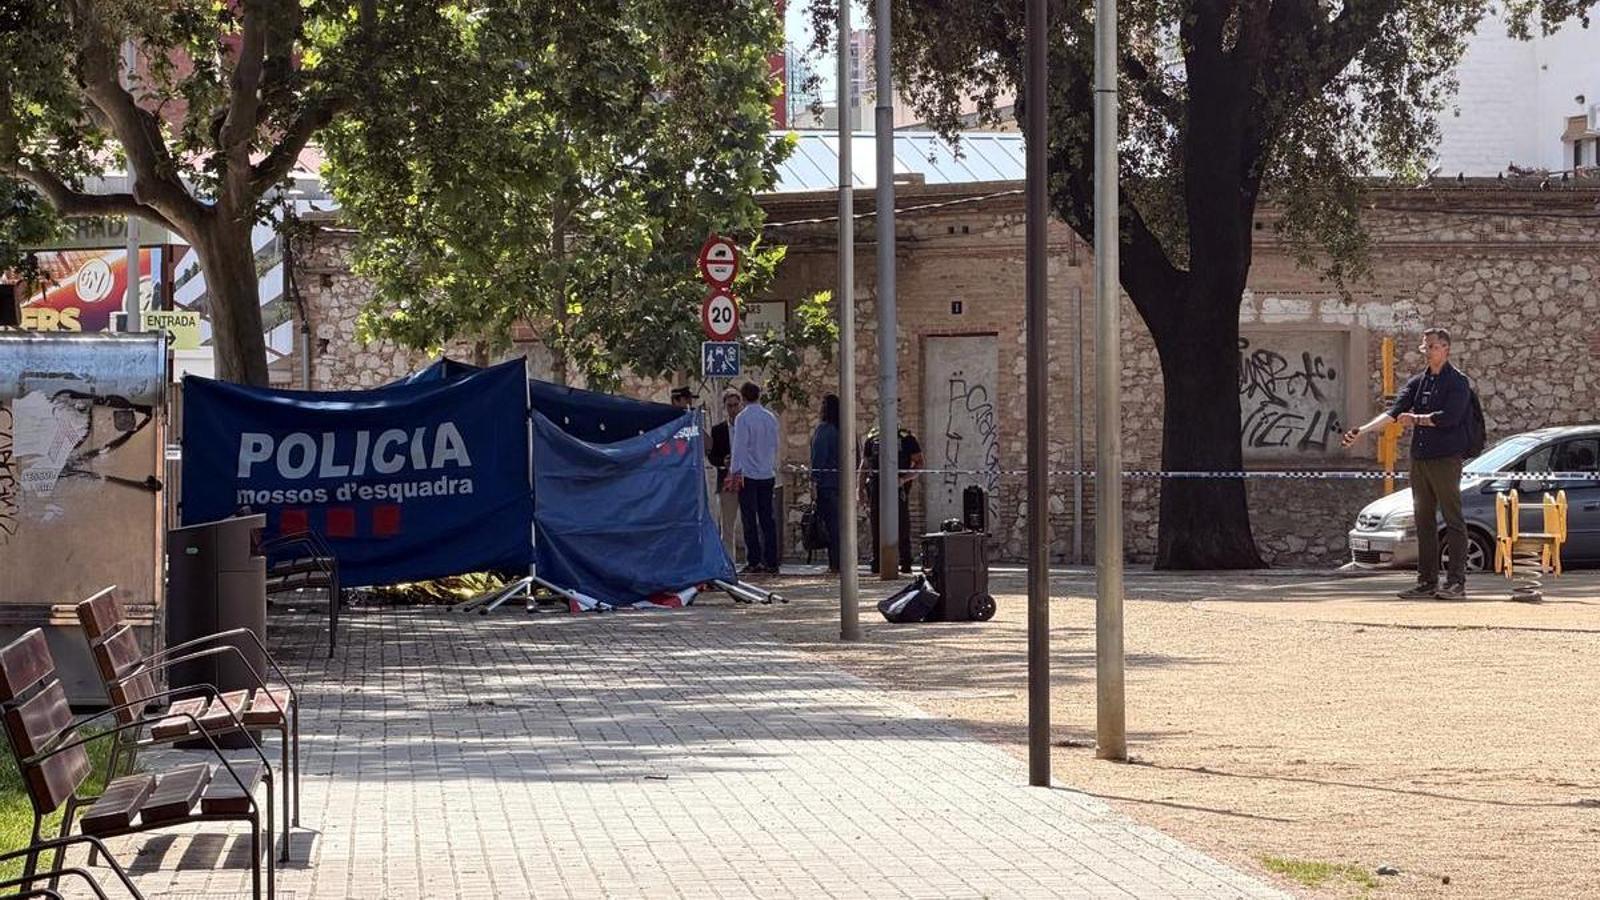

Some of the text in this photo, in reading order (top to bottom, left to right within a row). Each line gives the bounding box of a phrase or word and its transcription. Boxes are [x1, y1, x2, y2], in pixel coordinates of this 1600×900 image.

[147, 315, 196, 327] ENTRADA
[712, 307, 731, 323] 20
[237, 421, 472, 479] POLICIA
[237, 475, 473, 505] mossos d'esquadra
